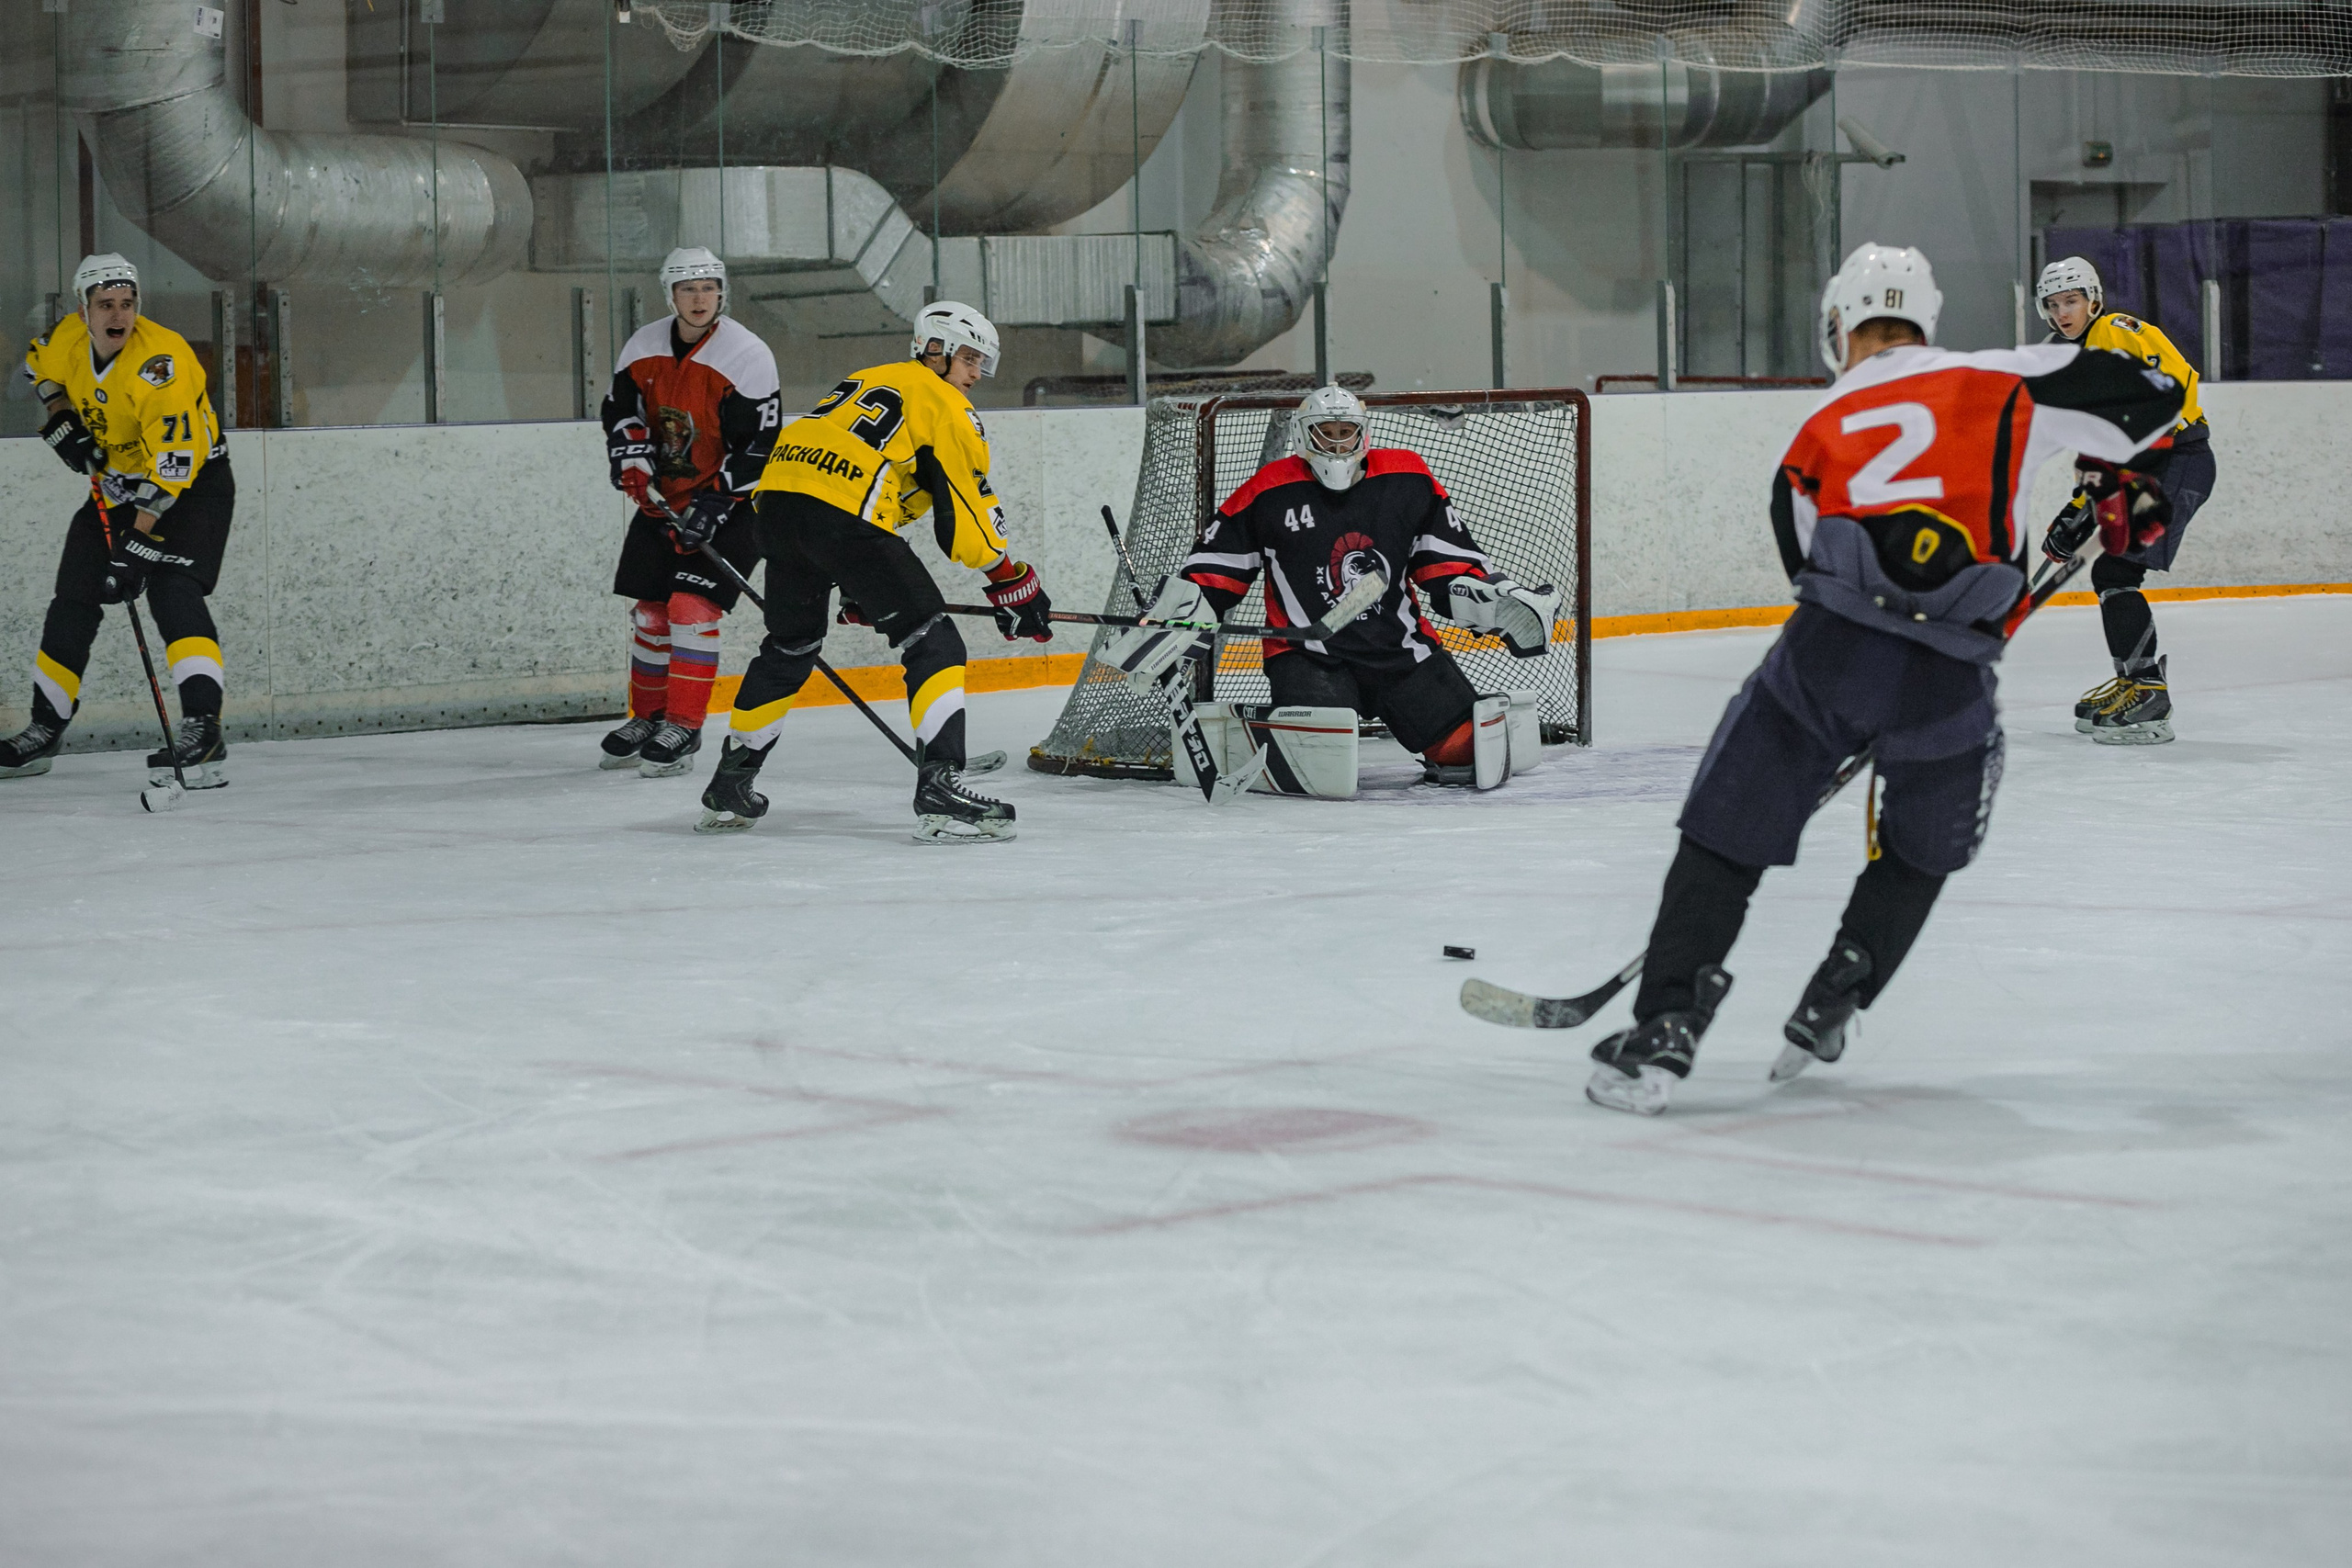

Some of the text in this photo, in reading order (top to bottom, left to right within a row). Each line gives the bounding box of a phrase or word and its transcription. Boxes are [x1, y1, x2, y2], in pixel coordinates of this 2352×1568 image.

[1885, 288, 1903, 310] 81
[162, 410, 193, 444] 71
[766, 444, 865, 482] РАСНОДАР
[1840, 401, 1945, 509] 2
[1283, 503, 1316, 532] 44
[1445, 504, 1465, 533] 4
[674, 571, 718, 590] CCM
[1277, 710, 1313, 718] WARRIOR
